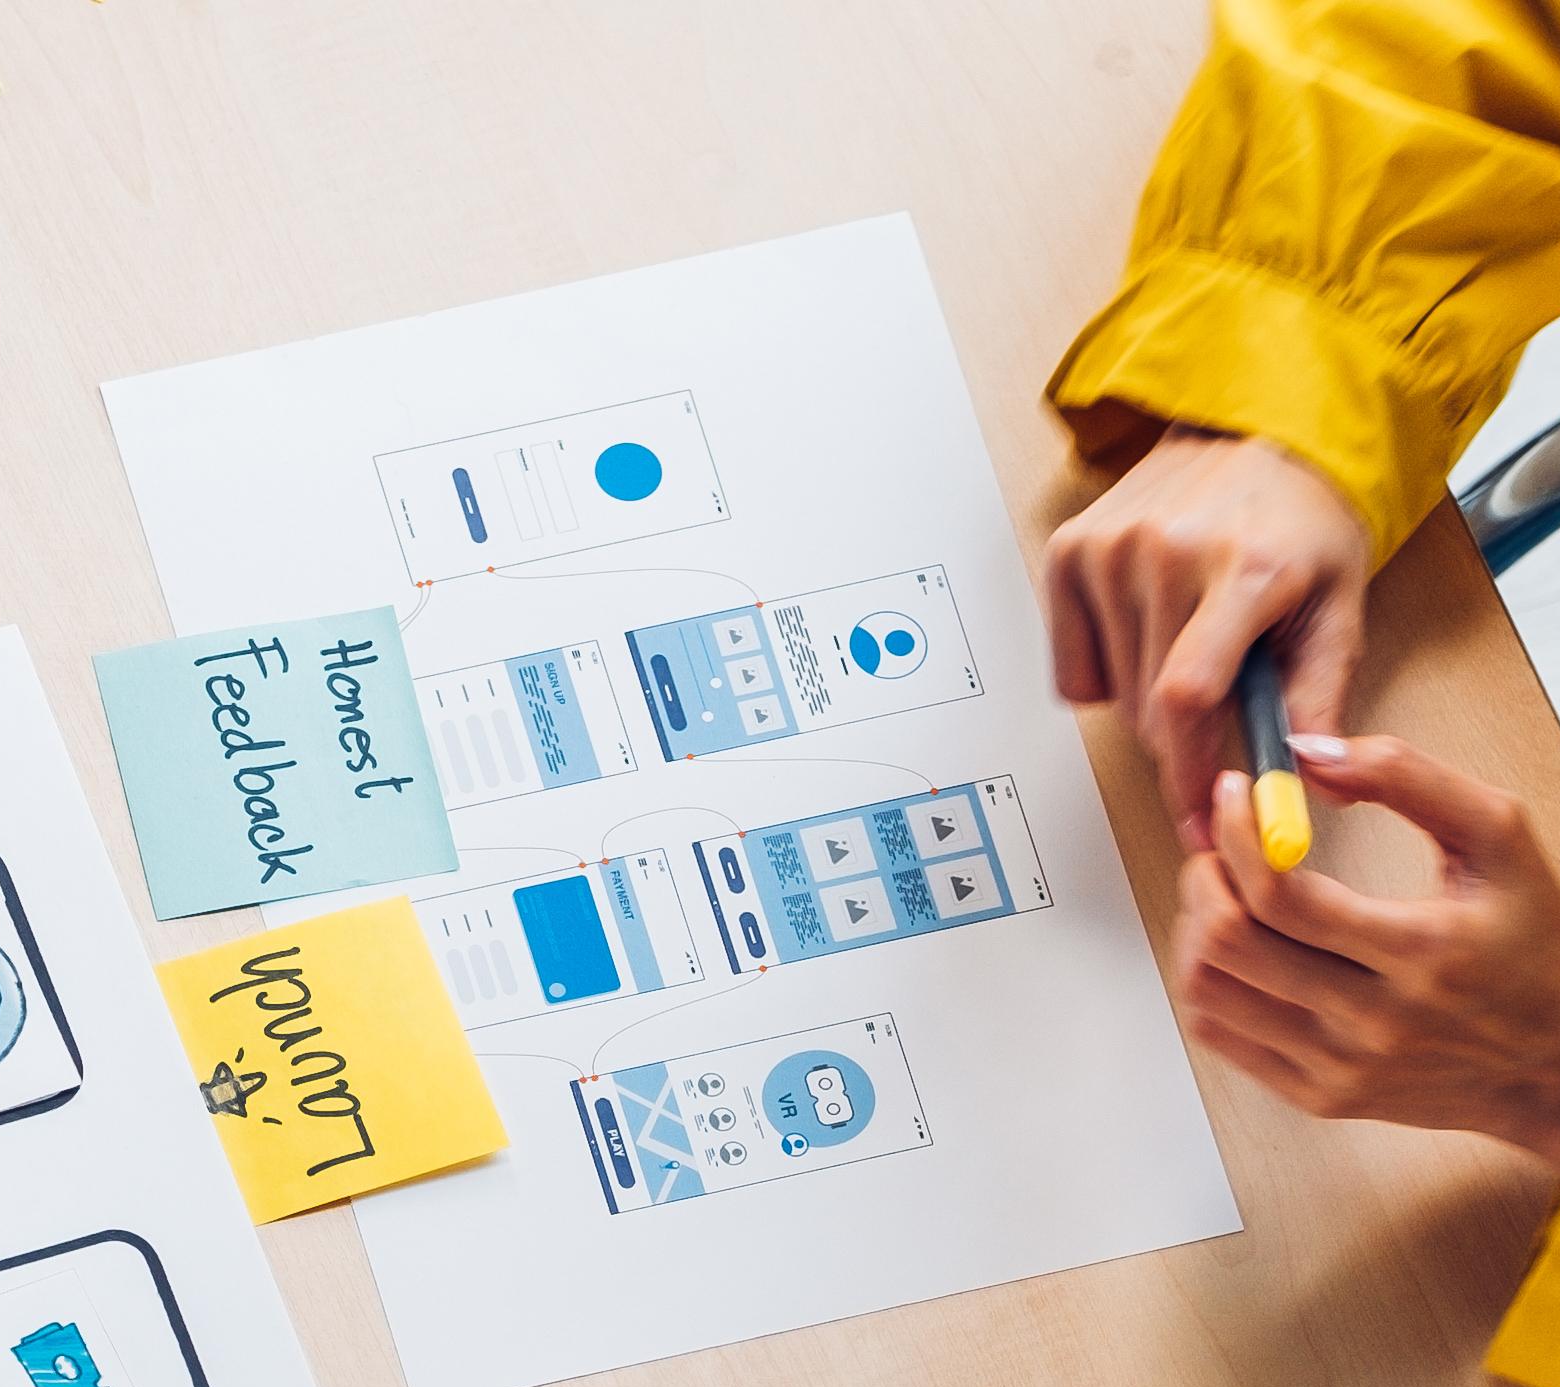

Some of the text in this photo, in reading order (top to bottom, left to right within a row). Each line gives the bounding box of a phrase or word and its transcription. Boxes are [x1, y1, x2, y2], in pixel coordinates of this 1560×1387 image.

[544, 662, 565, 704] SIGN UP
[320, 638, 414, 799] Honest
[194, 636, 314, 885] Feedback
[610, 870, 634, 919] PAYMENT
[209, 946, 376, 1177] Launch
[778, 1092, 797, 1118] VR
[607, 1129, 624, 1156] PLAY
